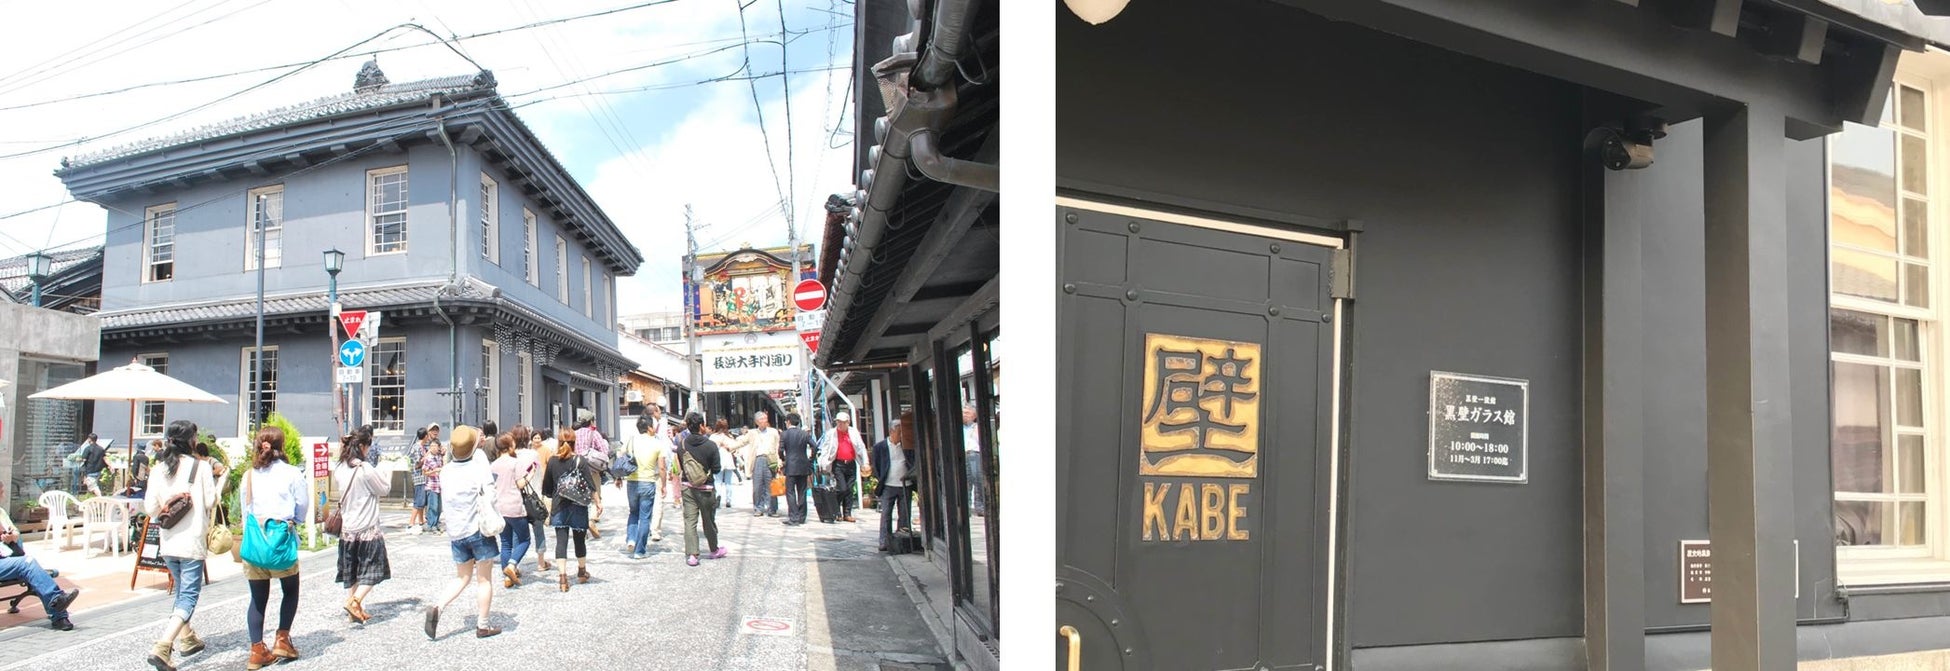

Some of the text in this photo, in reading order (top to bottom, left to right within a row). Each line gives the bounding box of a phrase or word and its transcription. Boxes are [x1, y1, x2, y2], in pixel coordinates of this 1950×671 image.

[1143, 347, 1259, 466] 壁
[1444, 404, 1516, 426] 黒壁ガラス館
[1142, 482, 1250, 541] KABE
